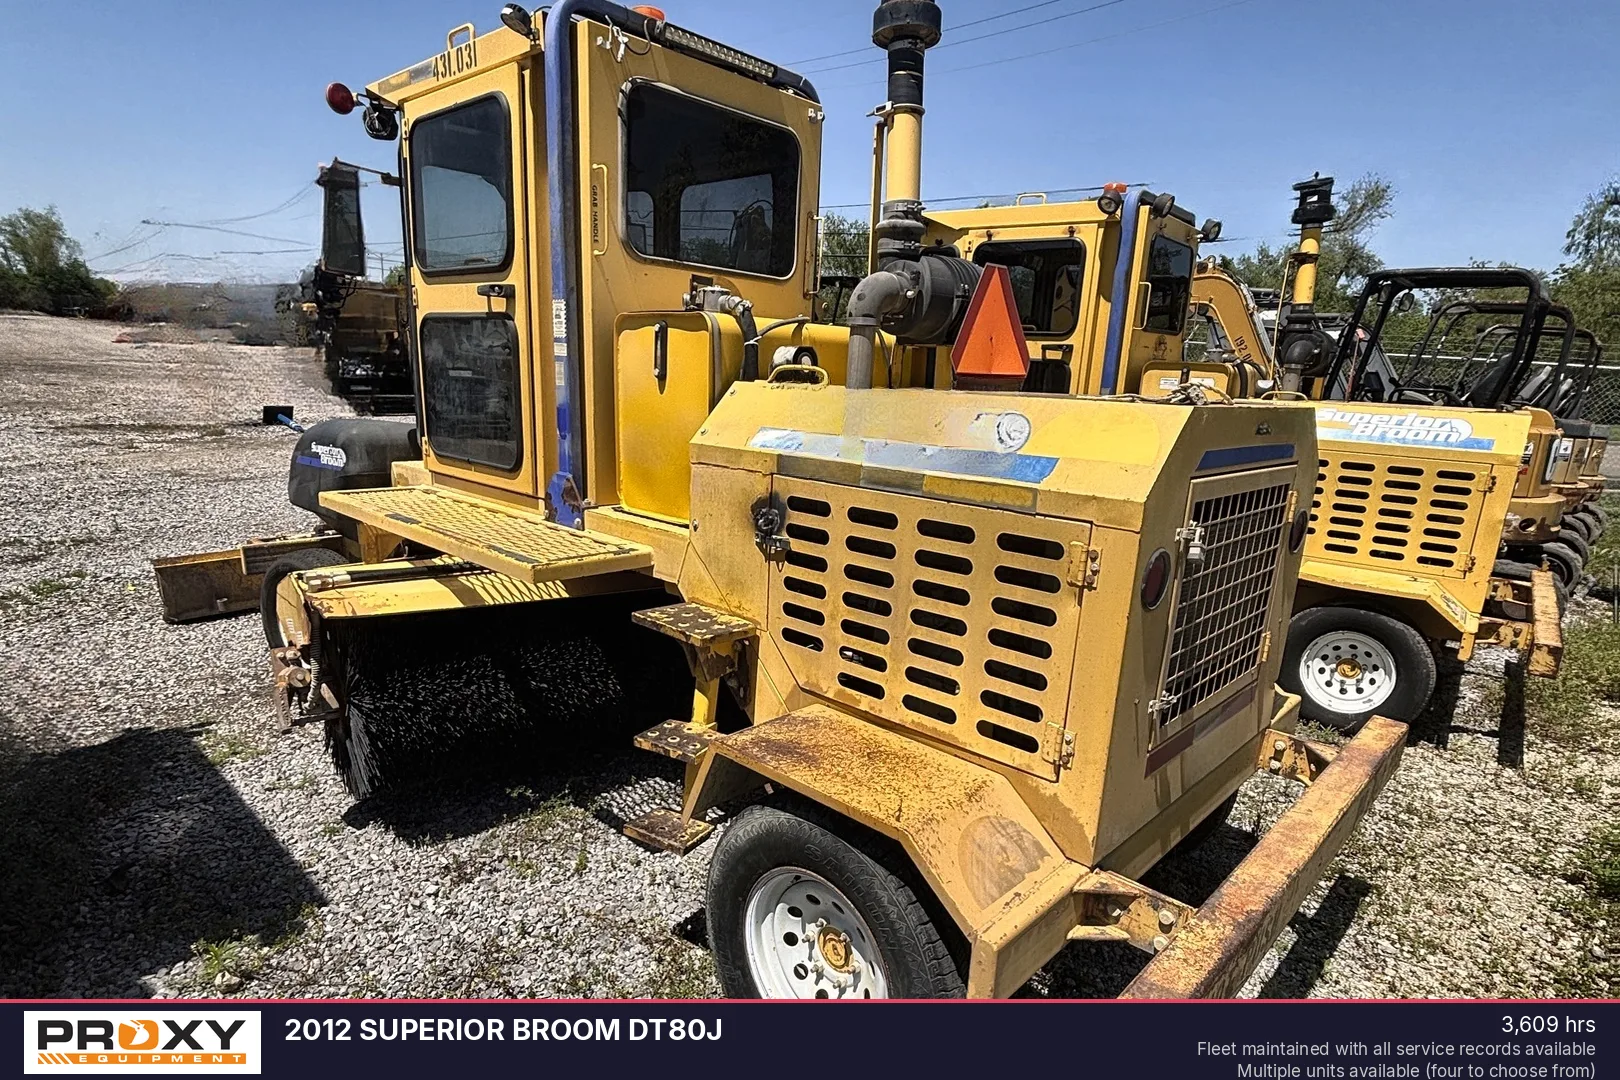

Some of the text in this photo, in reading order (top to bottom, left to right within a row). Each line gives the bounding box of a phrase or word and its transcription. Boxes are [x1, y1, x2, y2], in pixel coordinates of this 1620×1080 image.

[432, 40, 478, 82] 431.031
[1316, 408, 1451, 429] Superior
[1352, 422, 1462, 442] Broom
[311, 441, 346, 458] Superior
[320, 453, 345, 468] Broom
